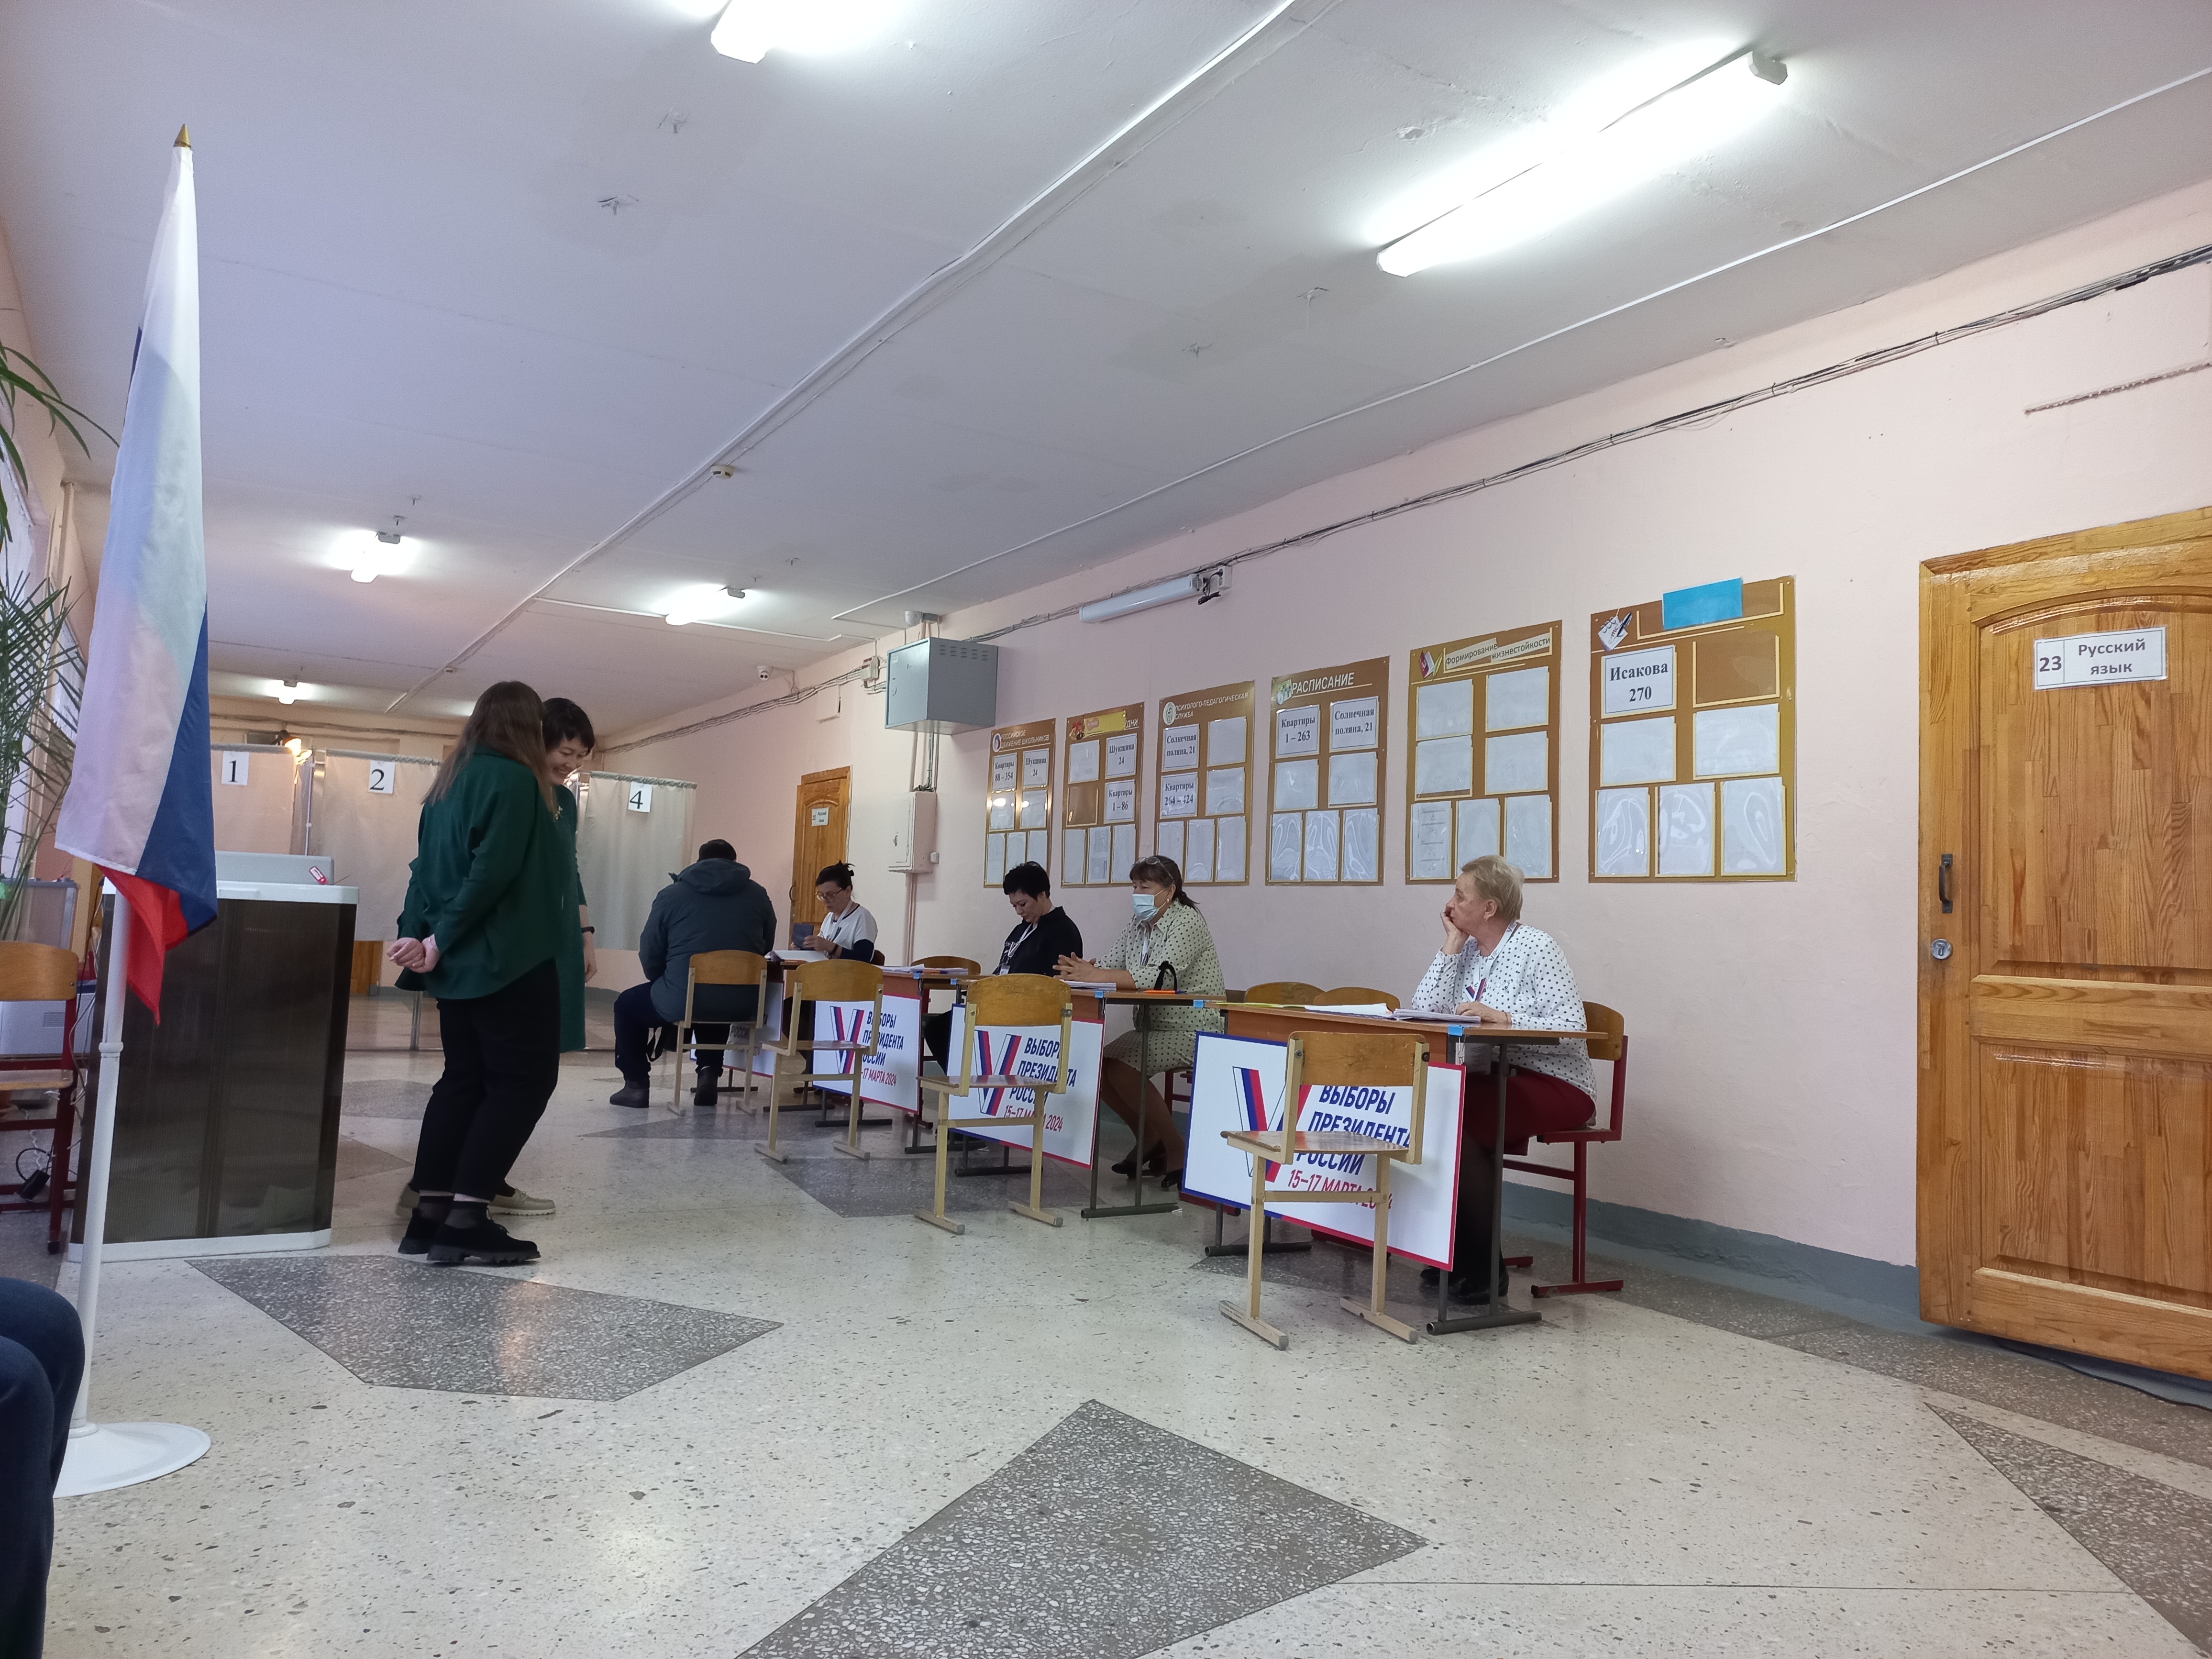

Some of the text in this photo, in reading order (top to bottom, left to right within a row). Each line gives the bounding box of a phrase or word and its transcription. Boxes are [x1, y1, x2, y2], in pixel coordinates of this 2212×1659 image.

[1446, 643, 1498, 665] Формирование
[1491, 637, 1550, 660] жизнестойкости
[2078, 638, 2146, 658] Русский
[1610, 662, 1669, 681] Исакова
[2039, 656, 2062, 672] 23
[2090, 663, 2133, 675] язык
[1292, 672, 1355, 695] РАСПИСАНИЕ
[1629, 686, 1652, 702] 270
[1335, 708, 1374, 720] Солнечная
[1125, 719, 1138, 728] ДНИ
[1281, 716, 1316, 729] Квартиры
[1335, 722, 1373, 735] поляна, 21
[1166, 734, 1197, 744] Солнечная
[1285, 733, 1289, 743] 1
[1297, 730, 1310, 742] 263
[1166, 745, 1195, 757] поляна, 21
[1118, 756, 1125, 765] 24
[229, 760, 238, 783] 1
[369, 769, 385, 791] 2
[1165, 782, 1194, 792] Квартиры
[629, 790, 643, 809] 4
[1108, 789, 1133, 798] Квартиры
[1164, 796, 1175, 806] 264
[1113, 802, 1115, 811] 1
[1121, 801, 1128, 810] 86
[867, 1011, 897, 1029] ВОРЫ
[863, 1030, 904, 1050] ПРИДЕНТА
[1024, 1037, 1061, 1059] ВЫБОР
[863, 1051, 886, 1066] ОССИИ
[868, 1069, 885, 1084] МАРТА
[885, 1073, 897, 1086] 2024
[1017, 1060, 1077, 1087] ПРЕЗИДТА
[1009, 1087, 1049, 1106] РОСС
[1319, 1085, 1396, 1115] ВЫБОРЫ
[1045, 1115, 1063, 1132] 2024
